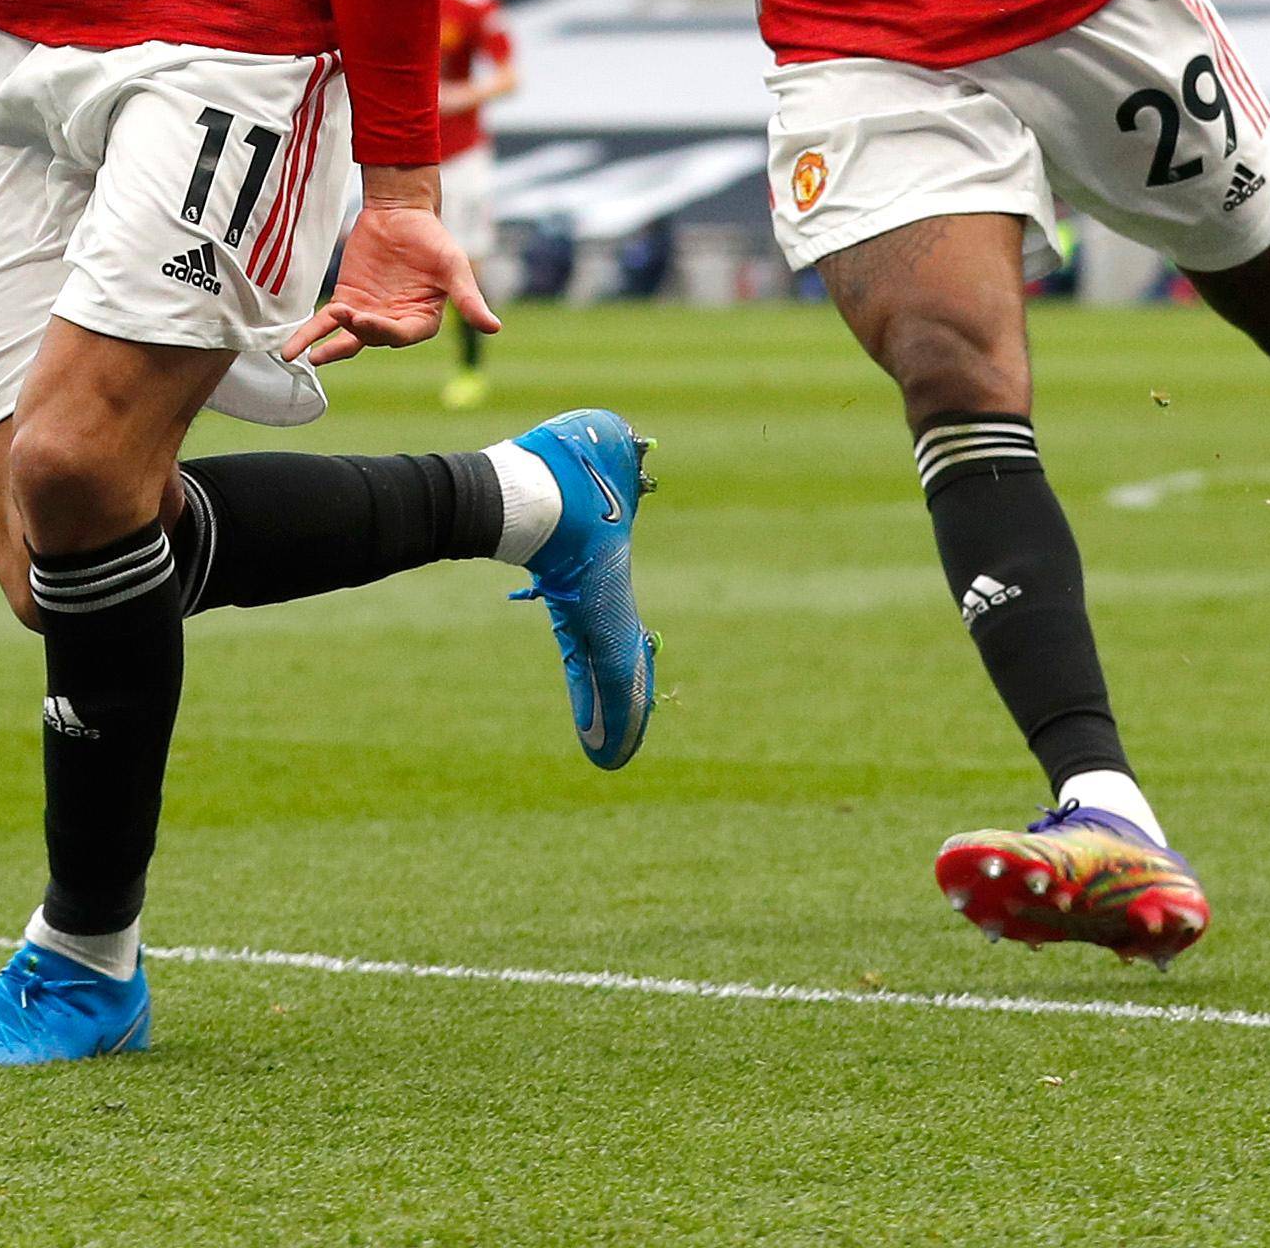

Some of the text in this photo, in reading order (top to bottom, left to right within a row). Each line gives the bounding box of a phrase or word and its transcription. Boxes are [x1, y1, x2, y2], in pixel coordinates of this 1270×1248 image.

[1115, 54, 1238, 188] 29
[180, 106, 282, 250] 11
[1223, 174, 1267, 212] adidas
[161, 262, 222, 296] adidas
